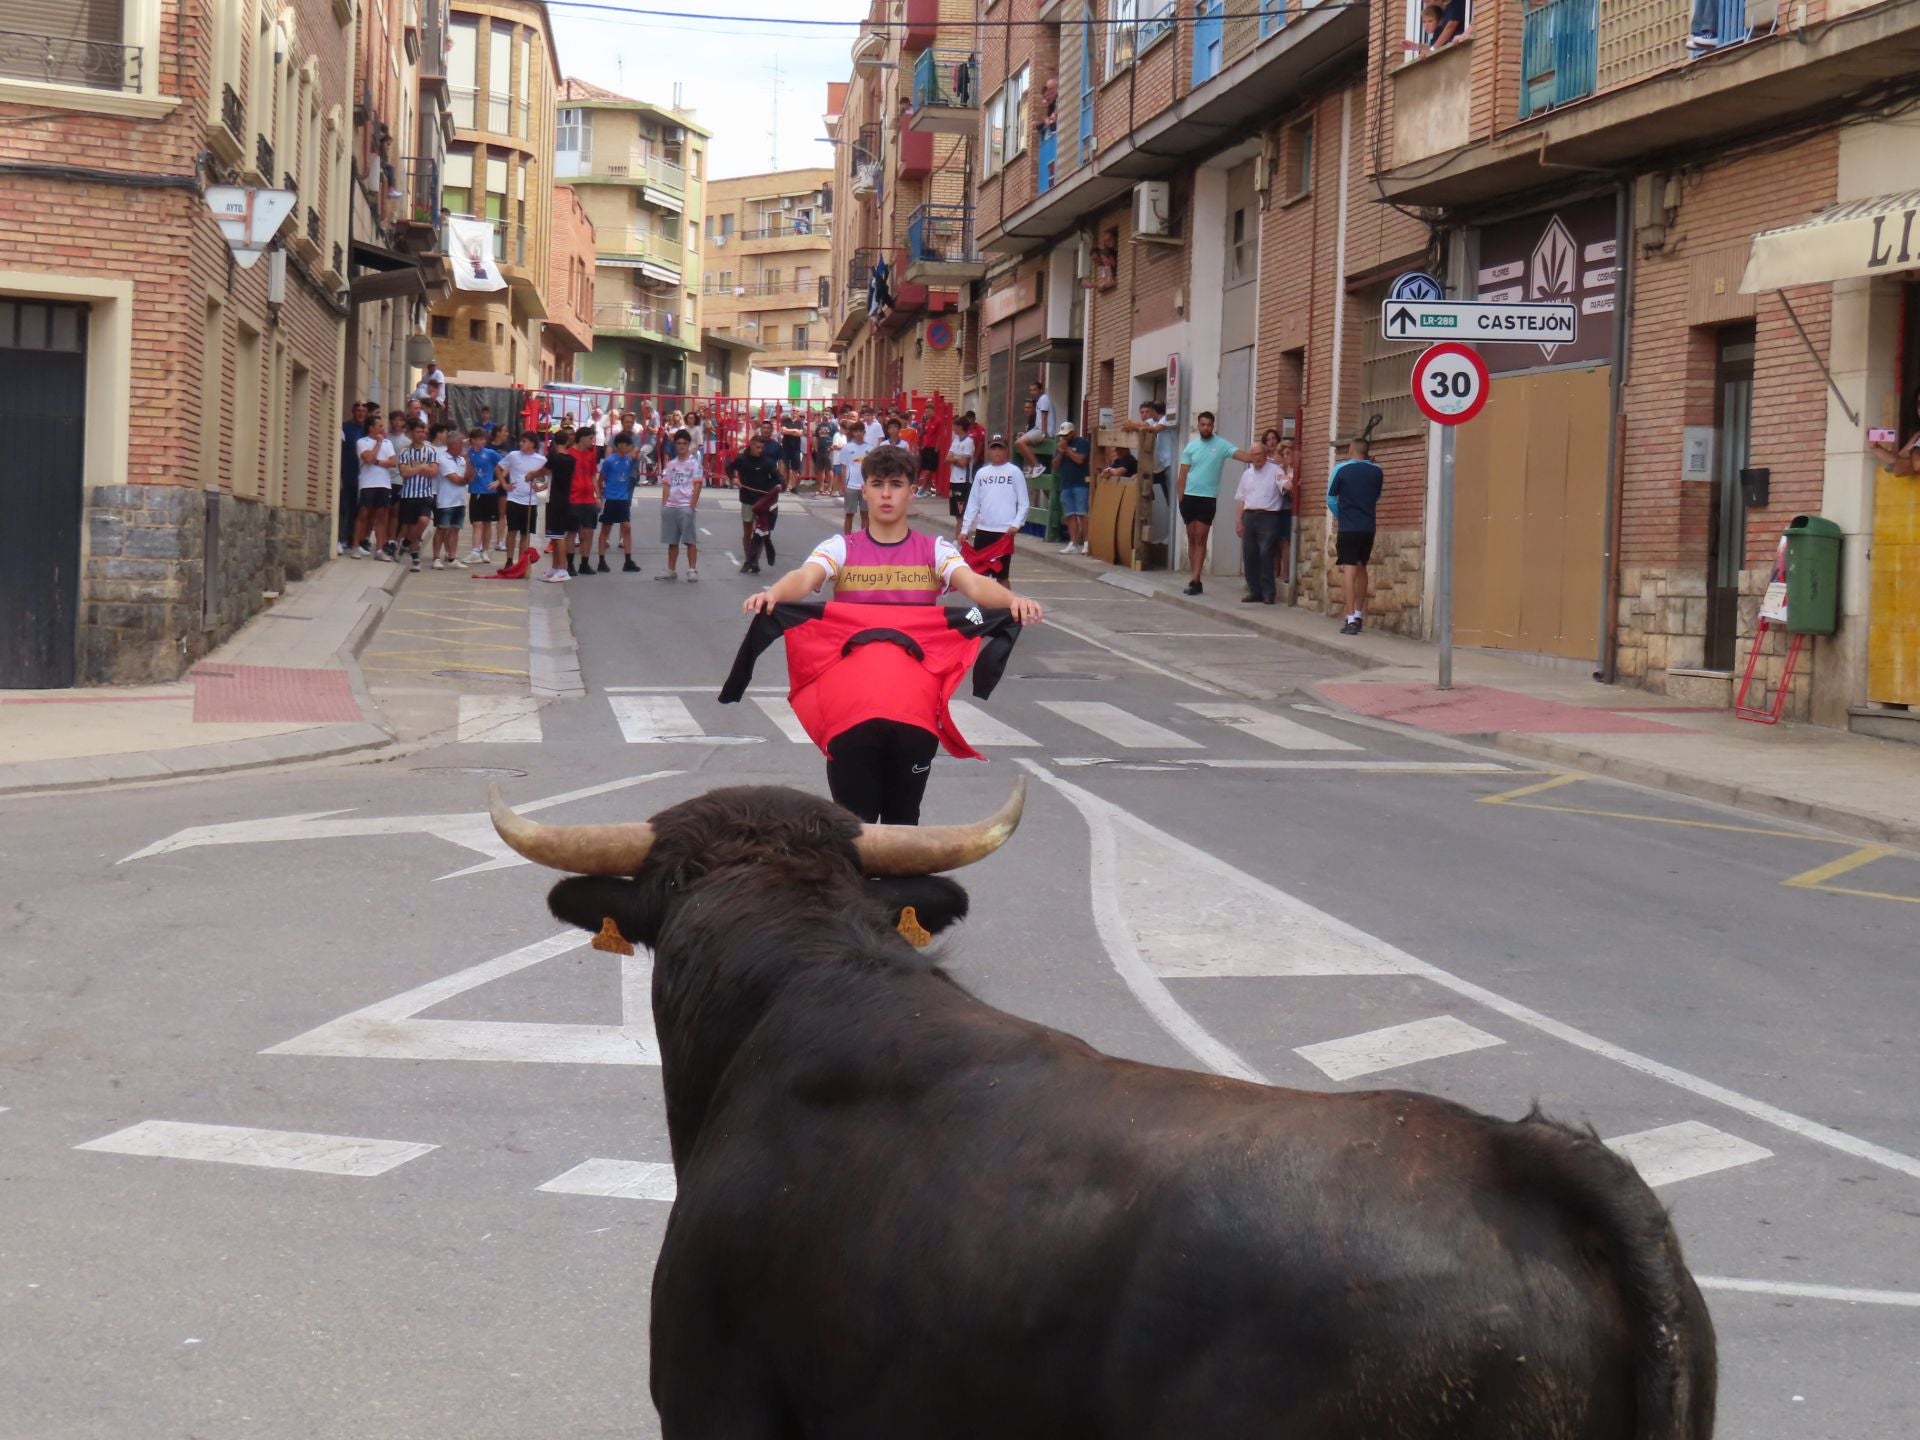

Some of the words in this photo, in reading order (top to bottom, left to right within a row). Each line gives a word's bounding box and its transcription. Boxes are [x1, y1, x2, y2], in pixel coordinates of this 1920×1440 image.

[1867, 209, 1920, 268] LI
[1423, 315, 1455, 326] LR-288
[1477, 313, 1571, 331] CASTEJÓN
[1429, 371, 1471, 398] 30
[979, 475, 1014, 487] INSIDE
[844, 571, 884, 585] Arruga
[885, 573, 893, 585] y
